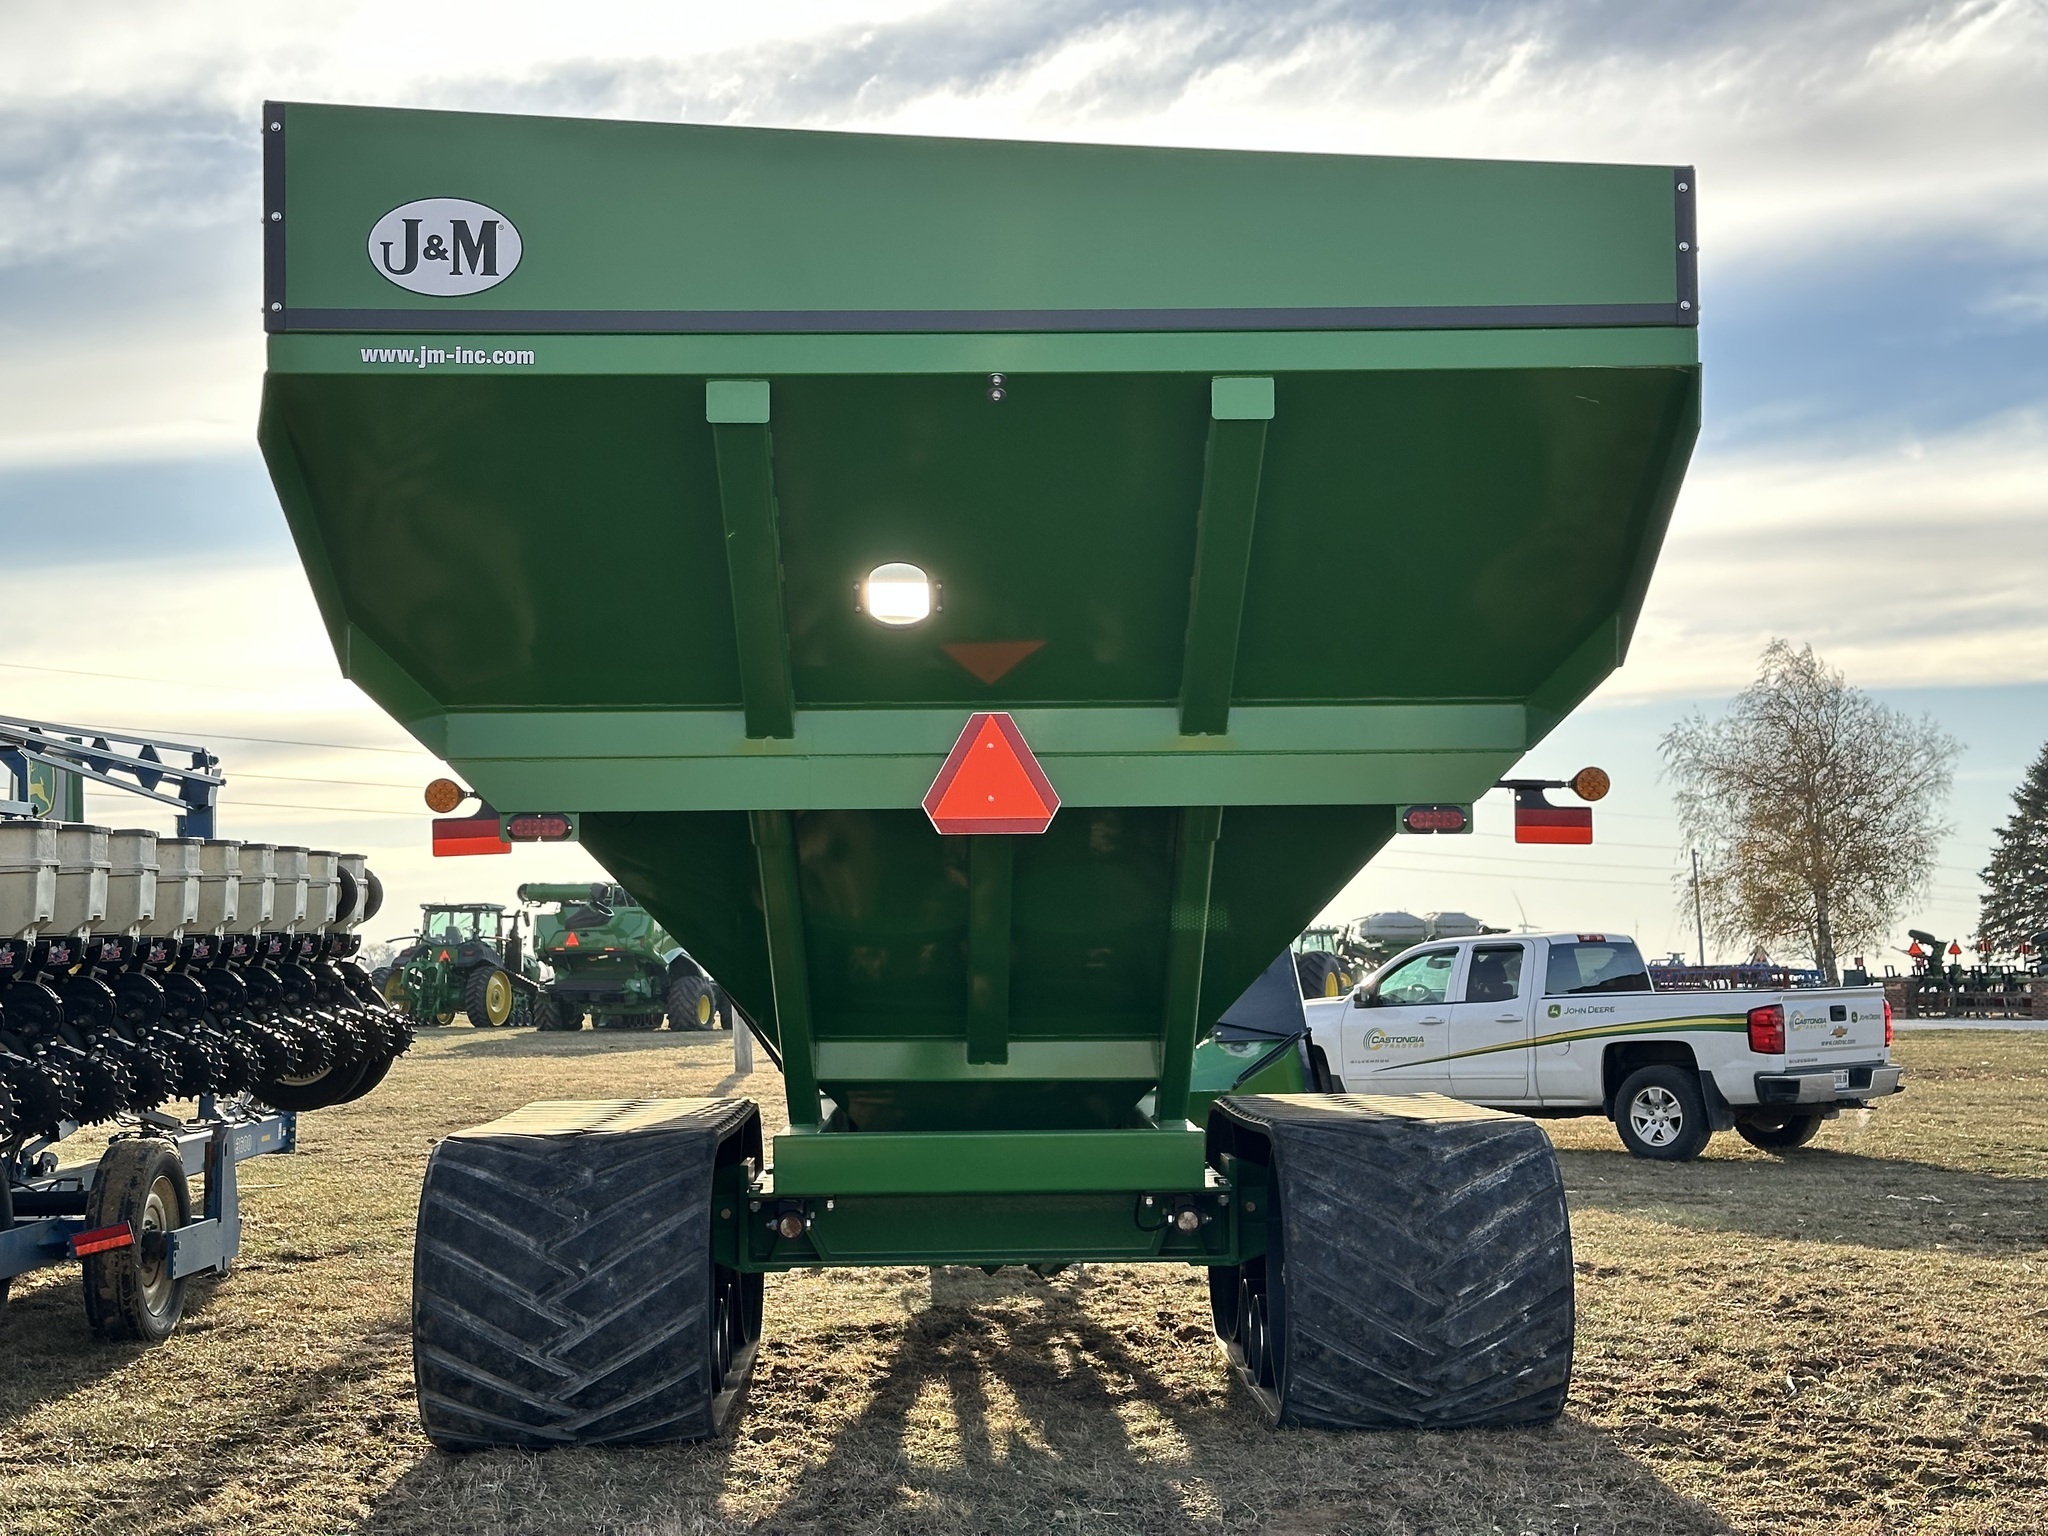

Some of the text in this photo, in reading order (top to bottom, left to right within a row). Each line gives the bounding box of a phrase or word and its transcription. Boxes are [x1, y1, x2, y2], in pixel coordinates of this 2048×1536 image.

[380, 219, 499, 276] J&M
[361, 346, 535, 369] www.jm-inc.com
[1564, 1006, 1586, 1014] JOHN
